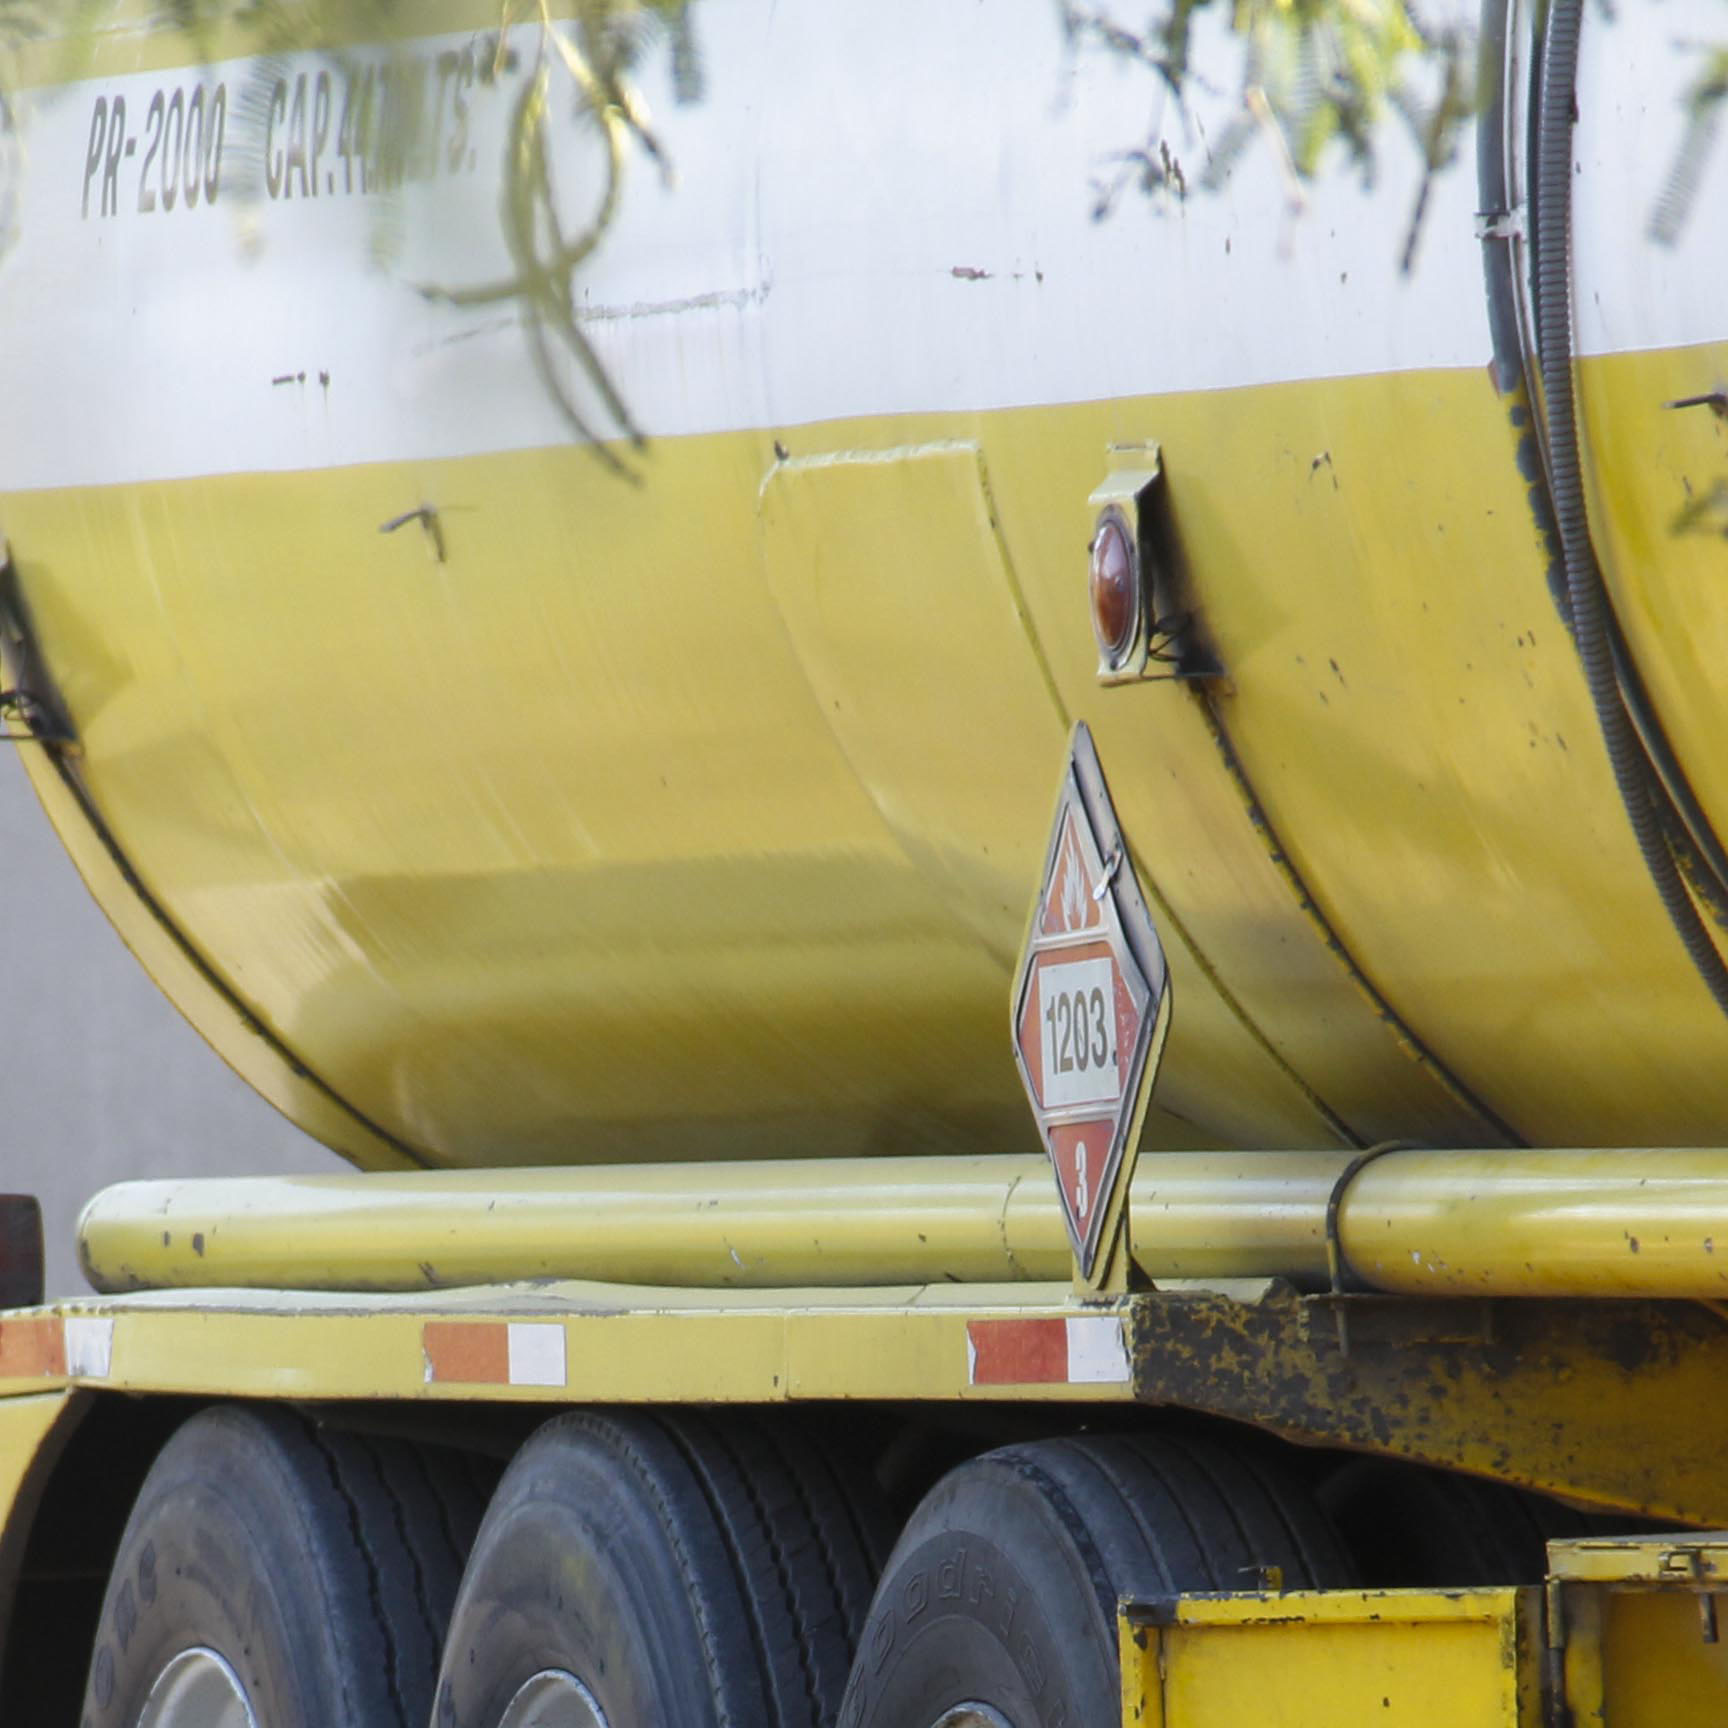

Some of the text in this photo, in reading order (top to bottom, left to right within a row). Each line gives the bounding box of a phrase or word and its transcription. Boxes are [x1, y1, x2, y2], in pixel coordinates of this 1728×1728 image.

[81, 82, 226, 220] PR-2000
[1046, 986, 1109, 1075] 1203
[1075, 1141, 1089, 1219] 3
